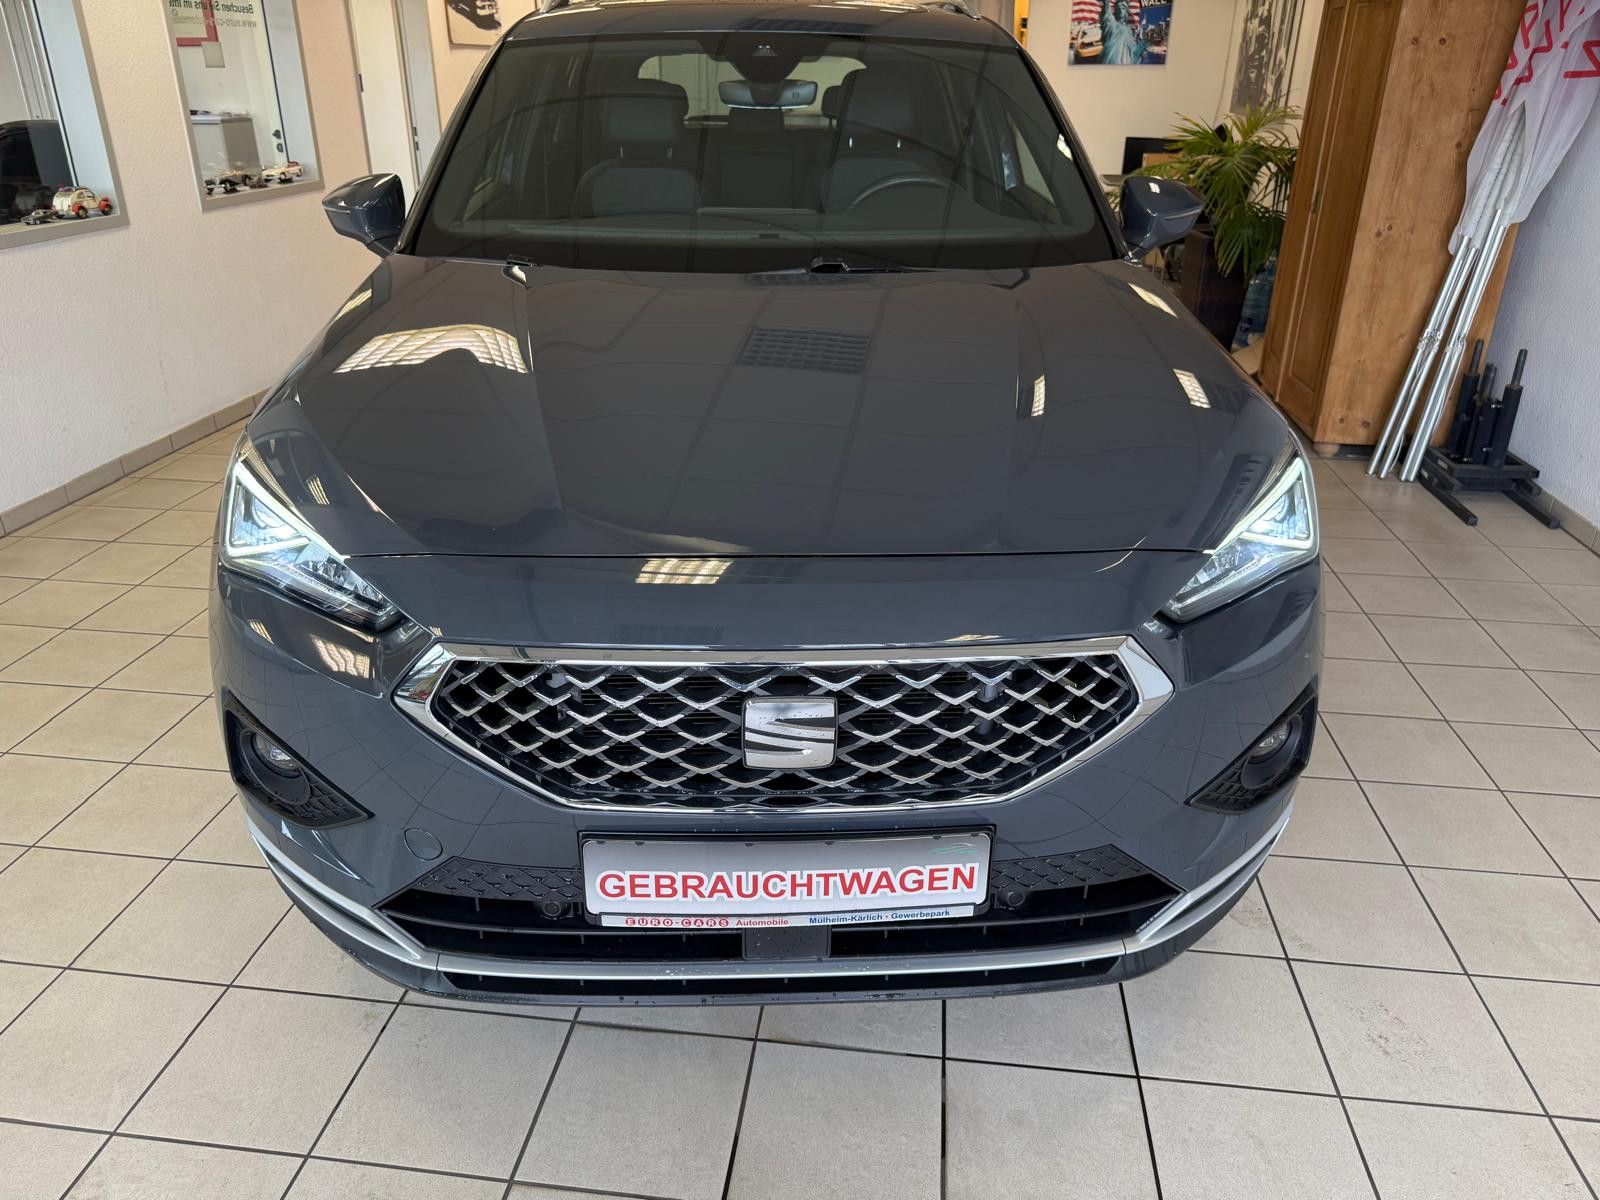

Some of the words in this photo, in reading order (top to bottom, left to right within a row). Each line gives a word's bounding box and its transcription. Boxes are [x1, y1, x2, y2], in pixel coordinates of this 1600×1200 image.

[597, 865, 977, 899] GEBRAUCHTWAGEN
[891, 910, 951, 920] Gewerbepark
[625, 917, 729, 928] EURO-CARS
[736, 918, 789, 927] Automobile
